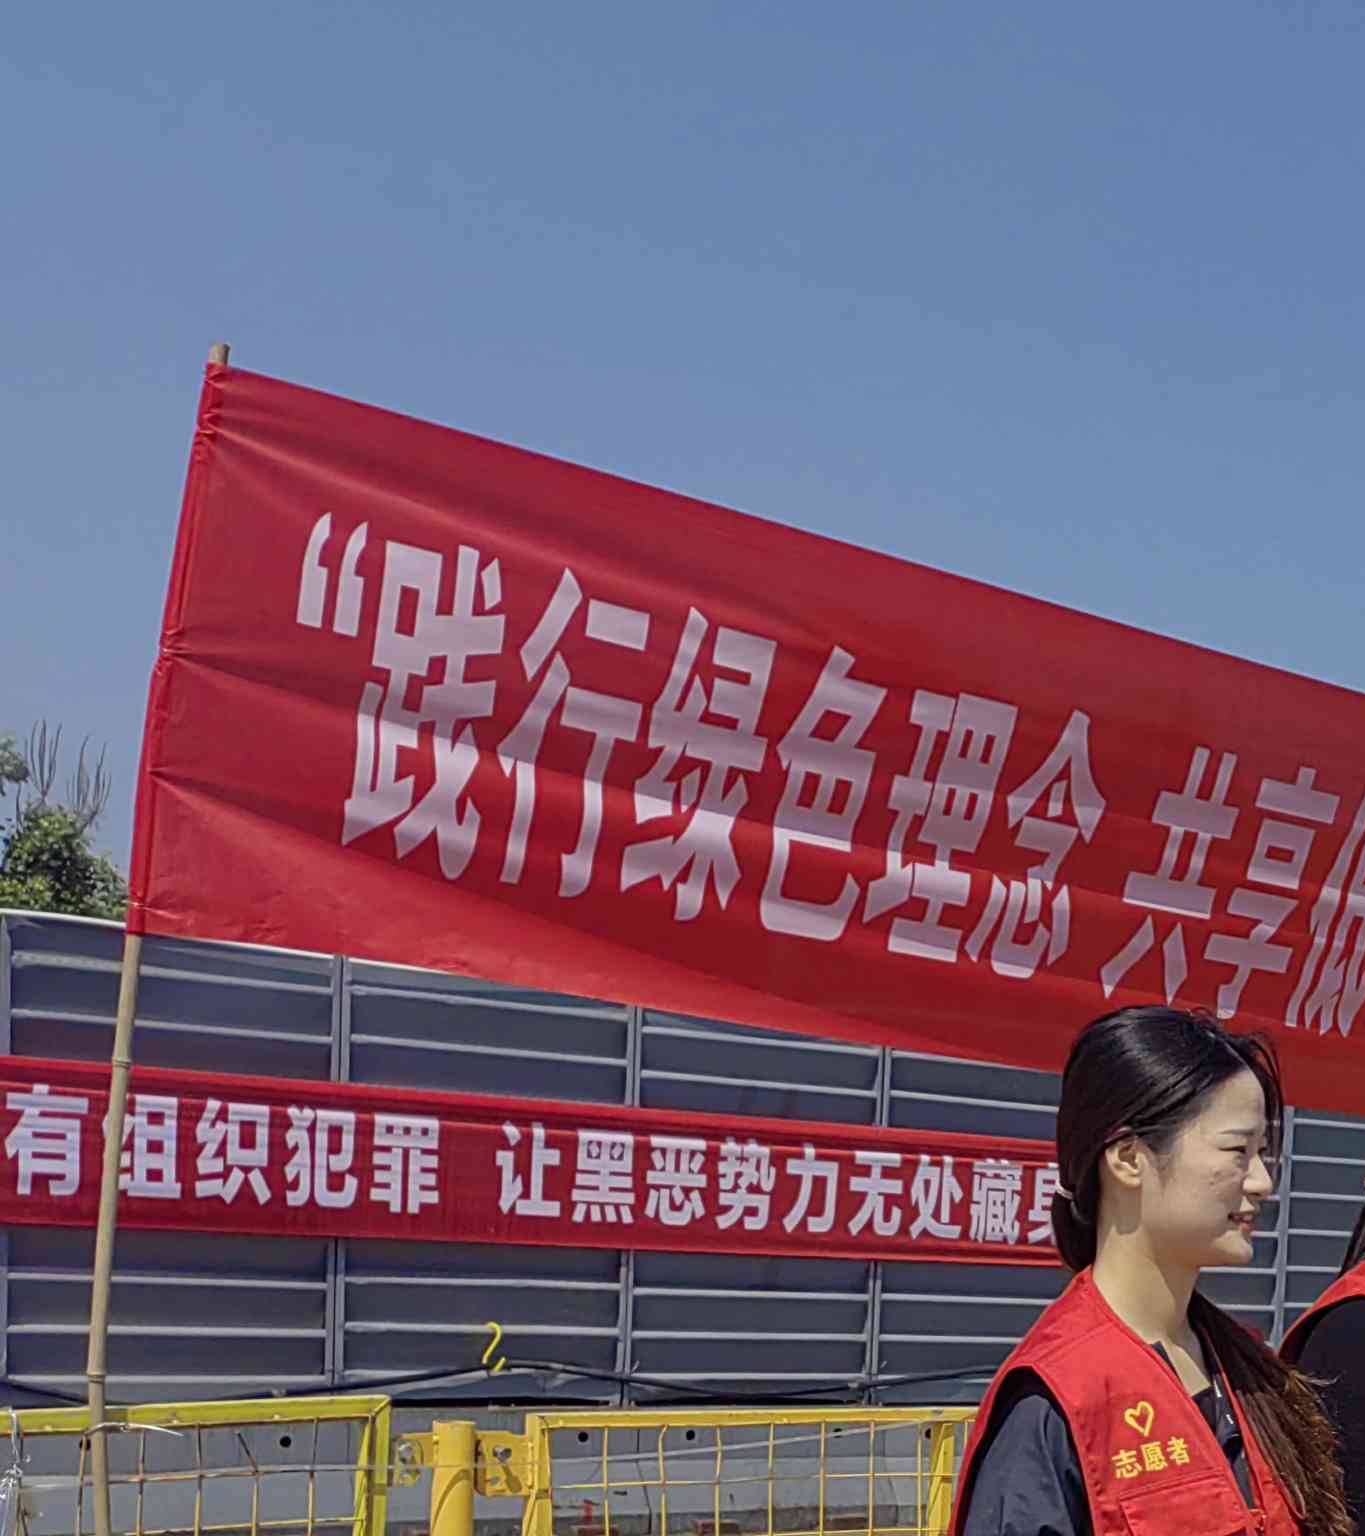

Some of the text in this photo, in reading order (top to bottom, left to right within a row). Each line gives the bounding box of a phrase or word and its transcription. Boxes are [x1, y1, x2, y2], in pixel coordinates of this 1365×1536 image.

[4, 1083, 1060, 1246] 有组织犯罪 让黑恶势力无处藏身
[1111, 1437, 1191, 1479] 志愿者
